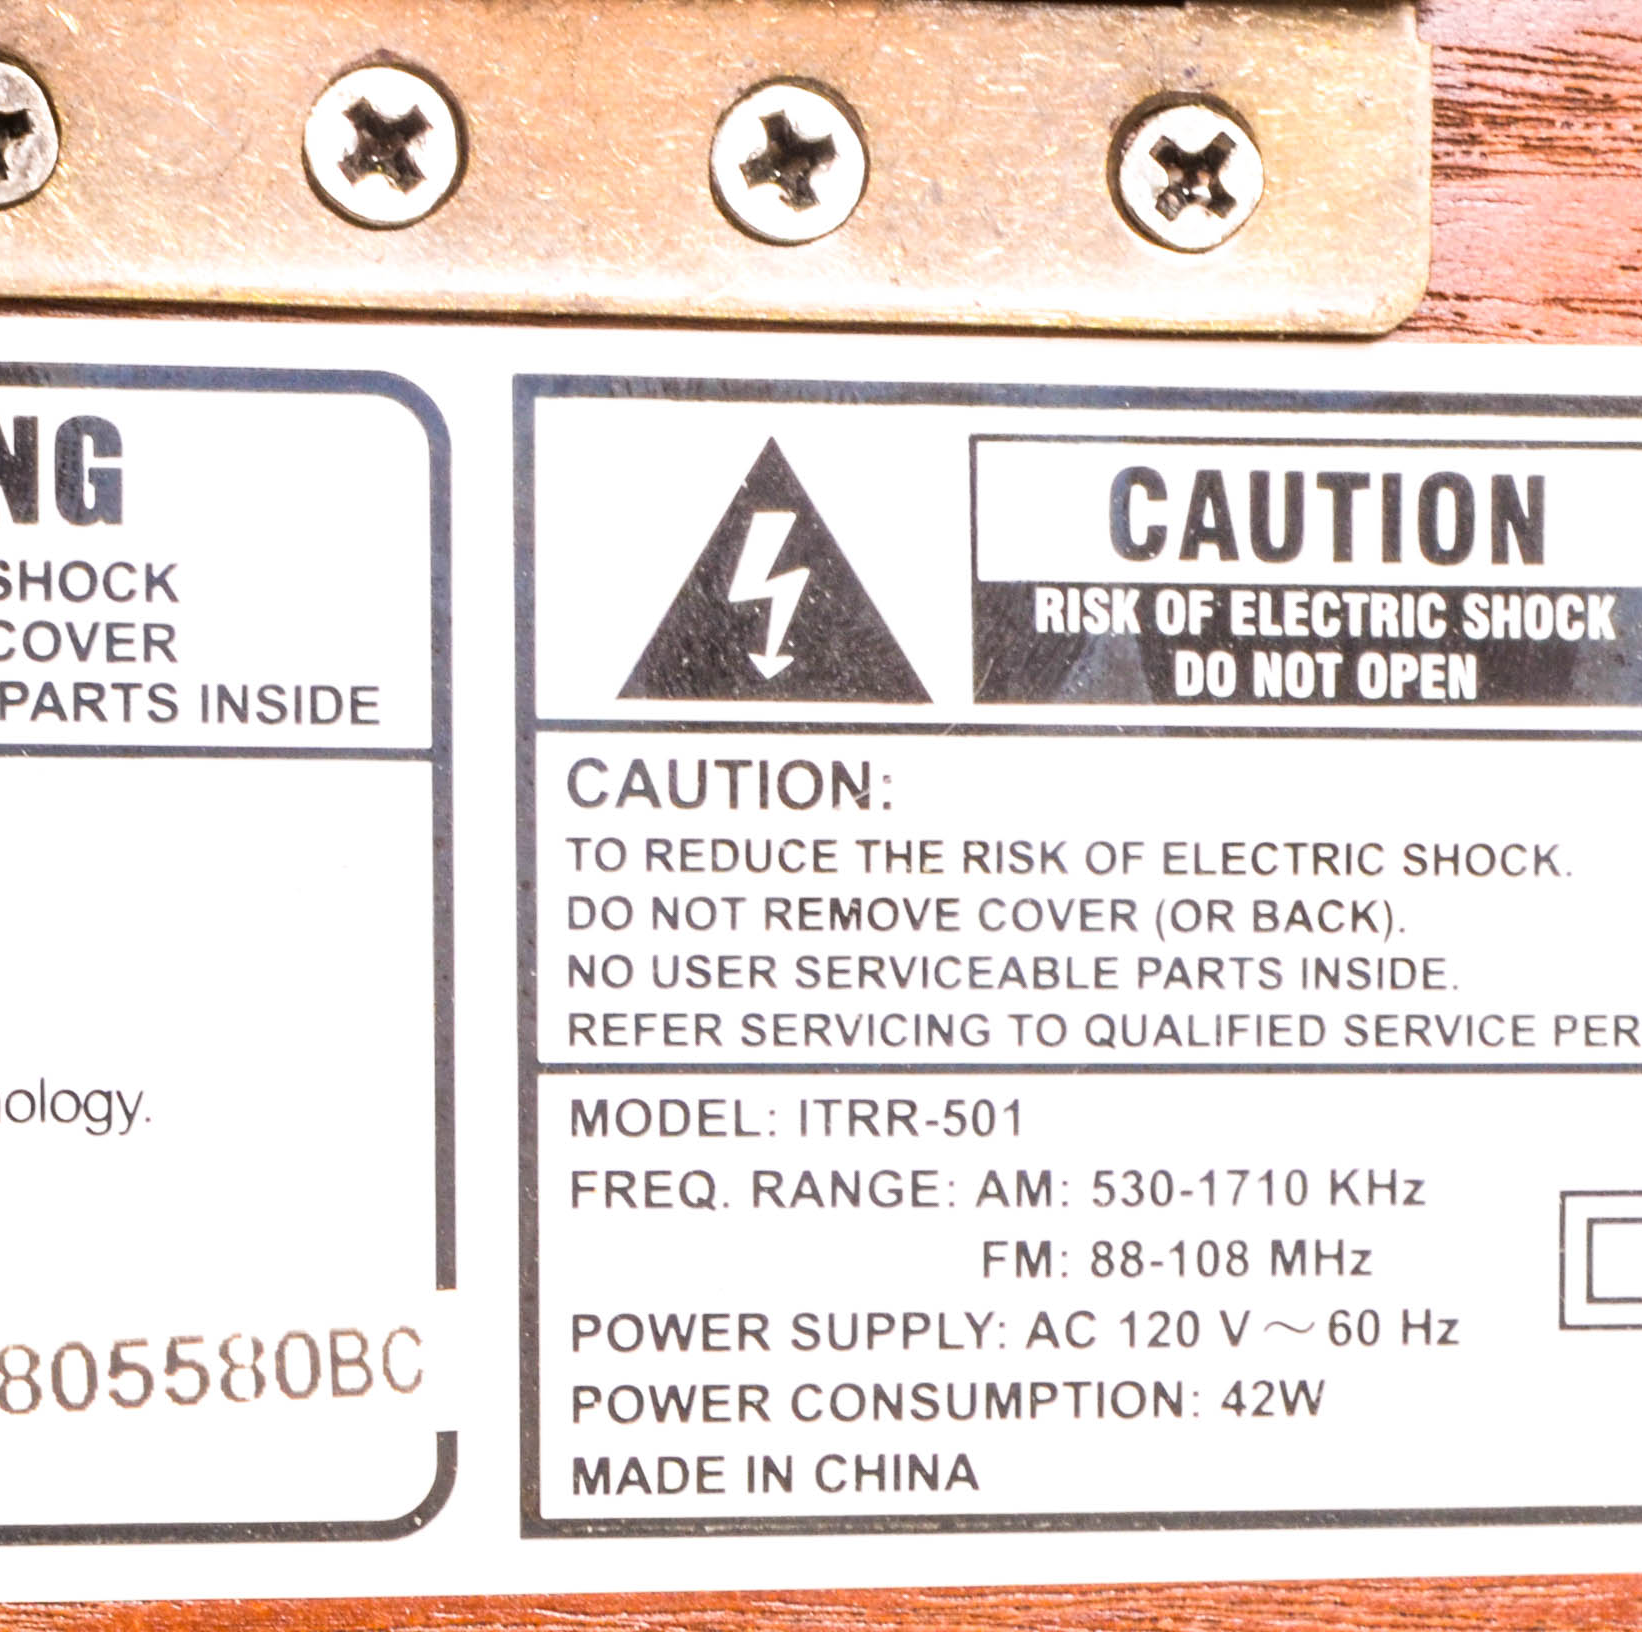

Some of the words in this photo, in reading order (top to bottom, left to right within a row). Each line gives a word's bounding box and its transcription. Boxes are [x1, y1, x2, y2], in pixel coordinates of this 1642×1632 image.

[1108, 464, 1546, 568] CAUTION
[1032, 584, 1143, 640] RISK
[1153, 587, 1223, 638] OF
[1229, 587, 1449, 641] ELECTRIC
[1461, 591, 1623, 645] SHOCK
[1173, 648, 1238, 700] DO
[1251, 649, 1345, 701] NOT
[1355, 649, 1479, 705] OPEN
[200, 682, 381, 726] INSIDE
[565, 756, 892, 812] CAUTION:
[564, 836, 628, 873] TO
[644, 836, 839, 875] REDUCE
[854, 838, 945, 875] THE
[962, 839, 1069, 876] RISK
[1084, 839, 1145, 877] OF
[1162, 840, 1385, 878] ELECTRIC
[1402, 841, 1573, 878] SHOCK.
[567, 894, 635, 933] DO
[651, 895, 748, 932] NOT
[763, 895, 961, 933] REMOVE
[977, 896, 1139, 933] COVER
[1154, 897, 1236, 943] (OR
[1251, 897, 1406, 943] BACK).
[567, 953, 635, 990] NO
[651, 953, 778, 990] USER
[794, 954, 1120, 991] SERVICEABLE
[1136, 955, 1284, 991] PARTS
[1301, 955, 1460, 992] INSIDE.
[567, 1011, 724, 1048] REFER
[740, 1011, 991, 1049] SERVICING
[1007, 1012, 1068, 1049] TO
[1084, 1012, 1327, 1050] QUALIFIED
[1343, 1012, 1536, 1049] SERVICE
[570, 1097, 777, 1139] MODEL:
[799, 1097, 1021, 1138] ITRR-501
[570, 1168, 730, 1212] FREQ.
[751, 1168, 956, 1210] RANGE:
[974, 1168, 1069, 1209] AM:
[1091, 1168, 1309, 1209] 530-1710
[1329, 1167, 1427, 1207] KHz
[982, 1239, 1069, 1279] FM:
[1089, 1238, 1250, 1279] 88-108
[1270, 1238, 1373, 1277] MHz
[571, 1311, 772, 1354] POWER
[790, 1310, 1006, 1353] SUPPLY:
[1024, 1309, 1097, 1350] AC
[1119, 1309, 1201, 1349] 120
[1218, 1308, 1252, 1348] V
[1327, 1308, 1381, 1348] 60
[1401, 1307, 1460, 1347] Hz
[571, 1383, 772, 1426] POWER
[790, 1379, 1200, 1424] CONSUMPTION:
[1220, 1378, 1326, 1418] 42W
[571, 1454, 727, 1497] MADE
[746, 1454, 794, 1495] IN
[814, 1452, 981, 1495] CHINA
